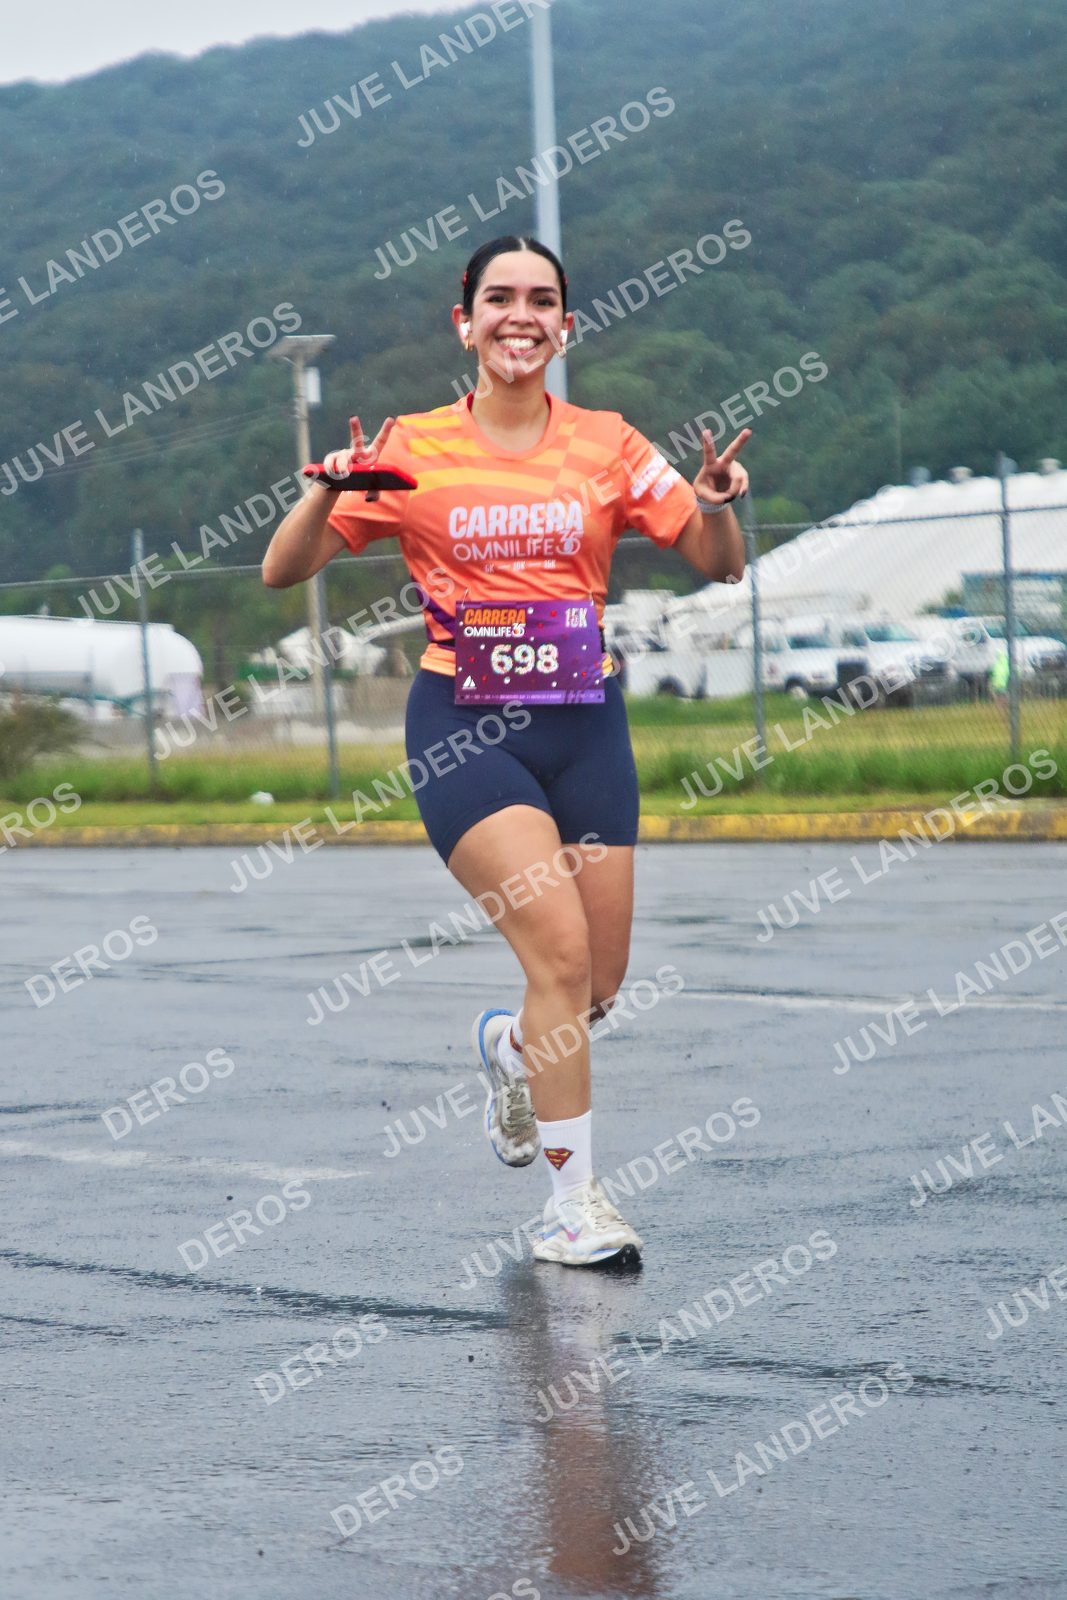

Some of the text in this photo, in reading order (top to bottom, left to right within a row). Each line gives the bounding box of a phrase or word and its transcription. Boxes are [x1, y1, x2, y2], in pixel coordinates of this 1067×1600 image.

[449, 500, 583, 539] CARRERA
[453, 538, 554, 561] OMNILIFE
[464, 608, 526, 625] CARRERA
[565, 608, 588, 627] 15K
[463, 626, 512, 637] OMNILIFE
[490, 643, 559, 675] 698
